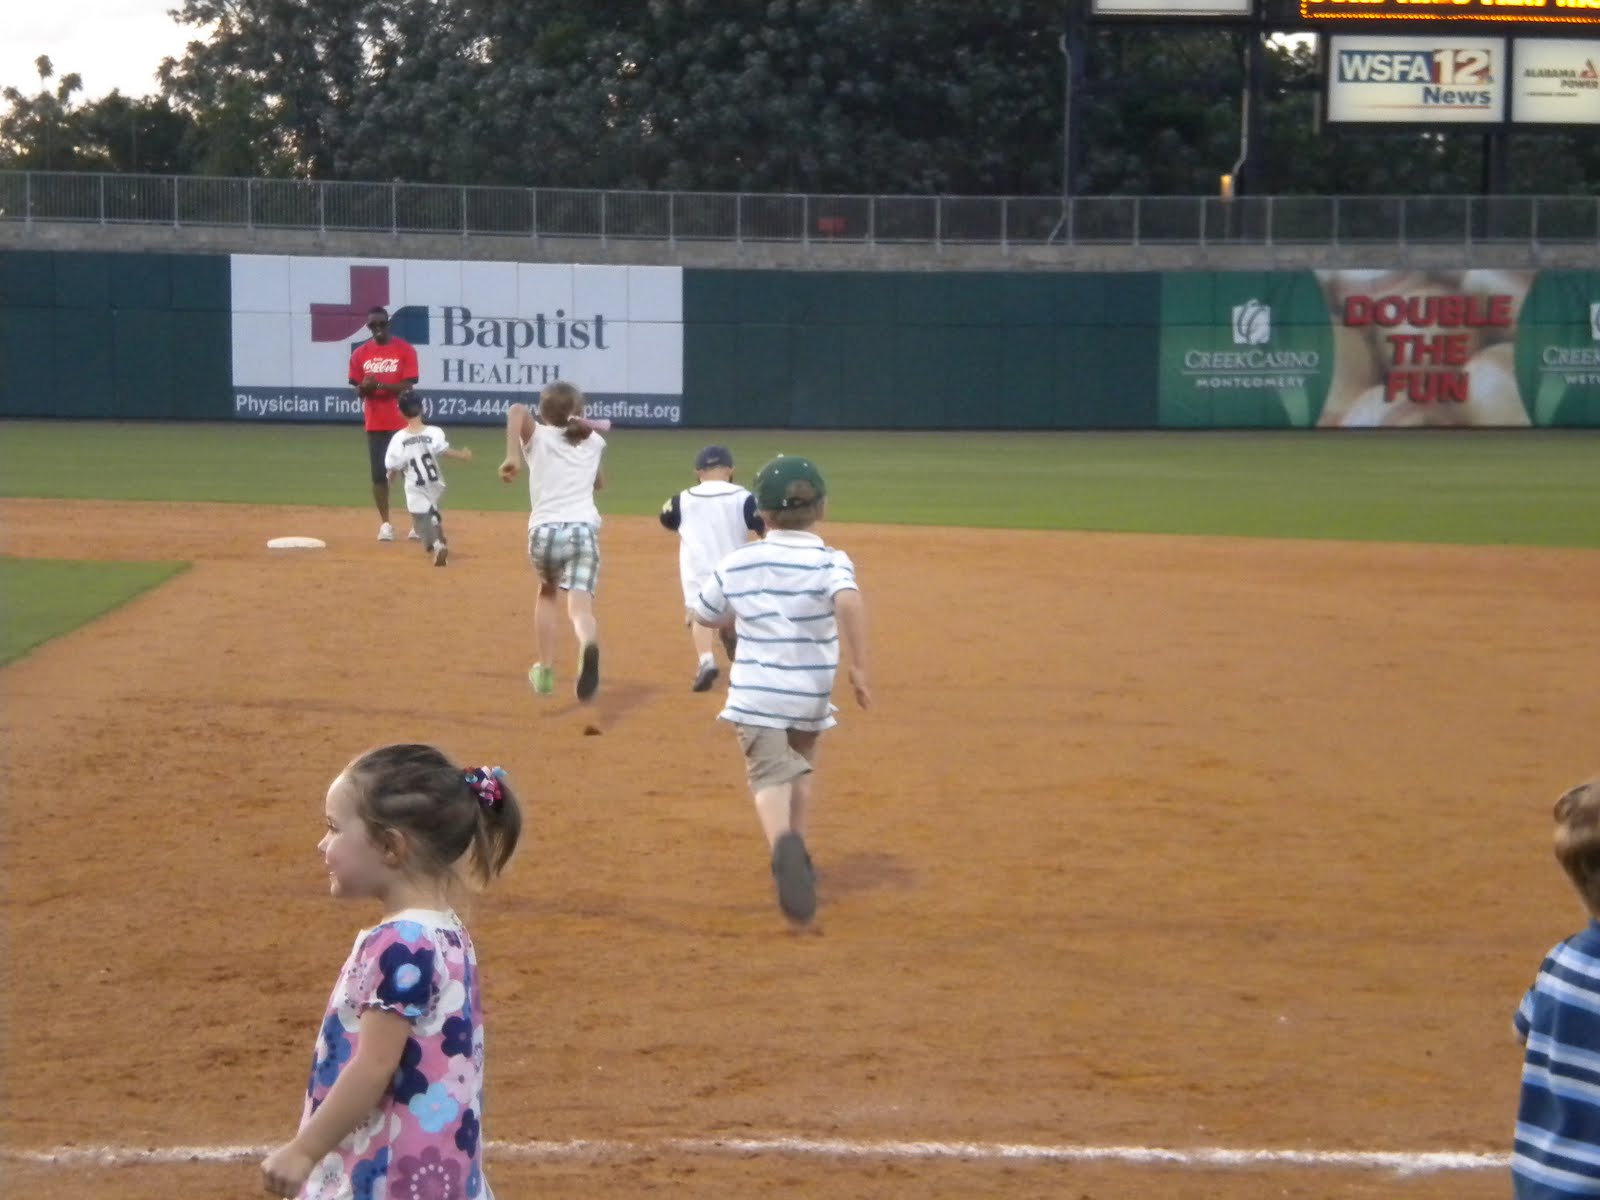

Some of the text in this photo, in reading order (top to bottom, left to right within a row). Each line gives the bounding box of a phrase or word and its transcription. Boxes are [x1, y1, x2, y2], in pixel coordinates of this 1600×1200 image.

[1340, 50, 1489, 84] WSFA 12
[1422, 87, 1490, 105] News
[1344, 295, 1513, 327] DOUBLE
[440, 306, 610, 359] Baptist
[1387, 334, 1469, 365] THE
[442, 359, 560, 384] HEALTH
[1384, 371, 1469, 402] FUN
[236, 394, 319, 416] Physician
[324, 396, 366, 413] Find
[438, 397, 510, 415] 273-4444
[410, 452, 439, 486] 16
